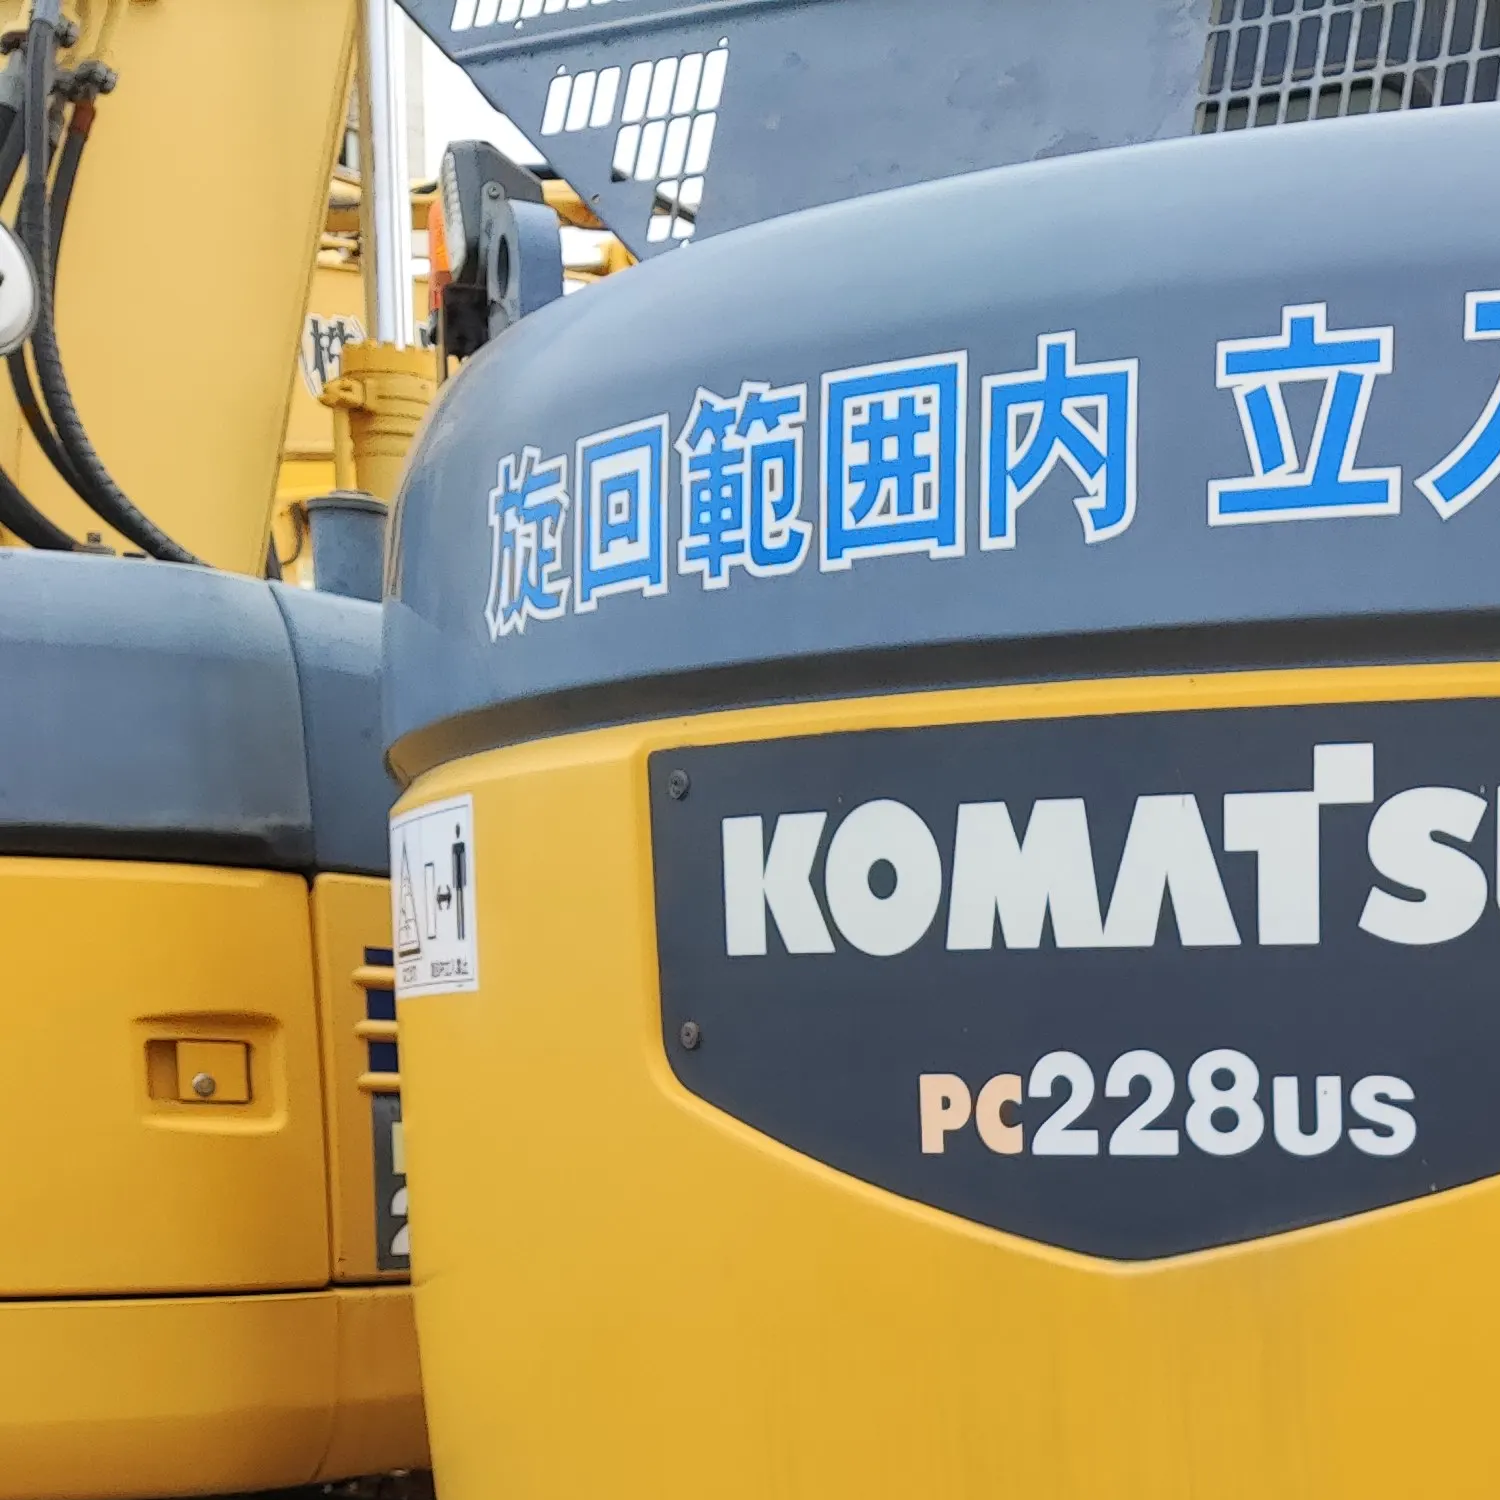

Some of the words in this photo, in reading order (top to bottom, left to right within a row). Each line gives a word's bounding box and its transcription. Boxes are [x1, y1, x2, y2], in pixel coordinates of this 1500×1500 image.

[485, 330, 1138, 642] 旋回範囲内
[919, 1049, 1417, 1156] PC228US
